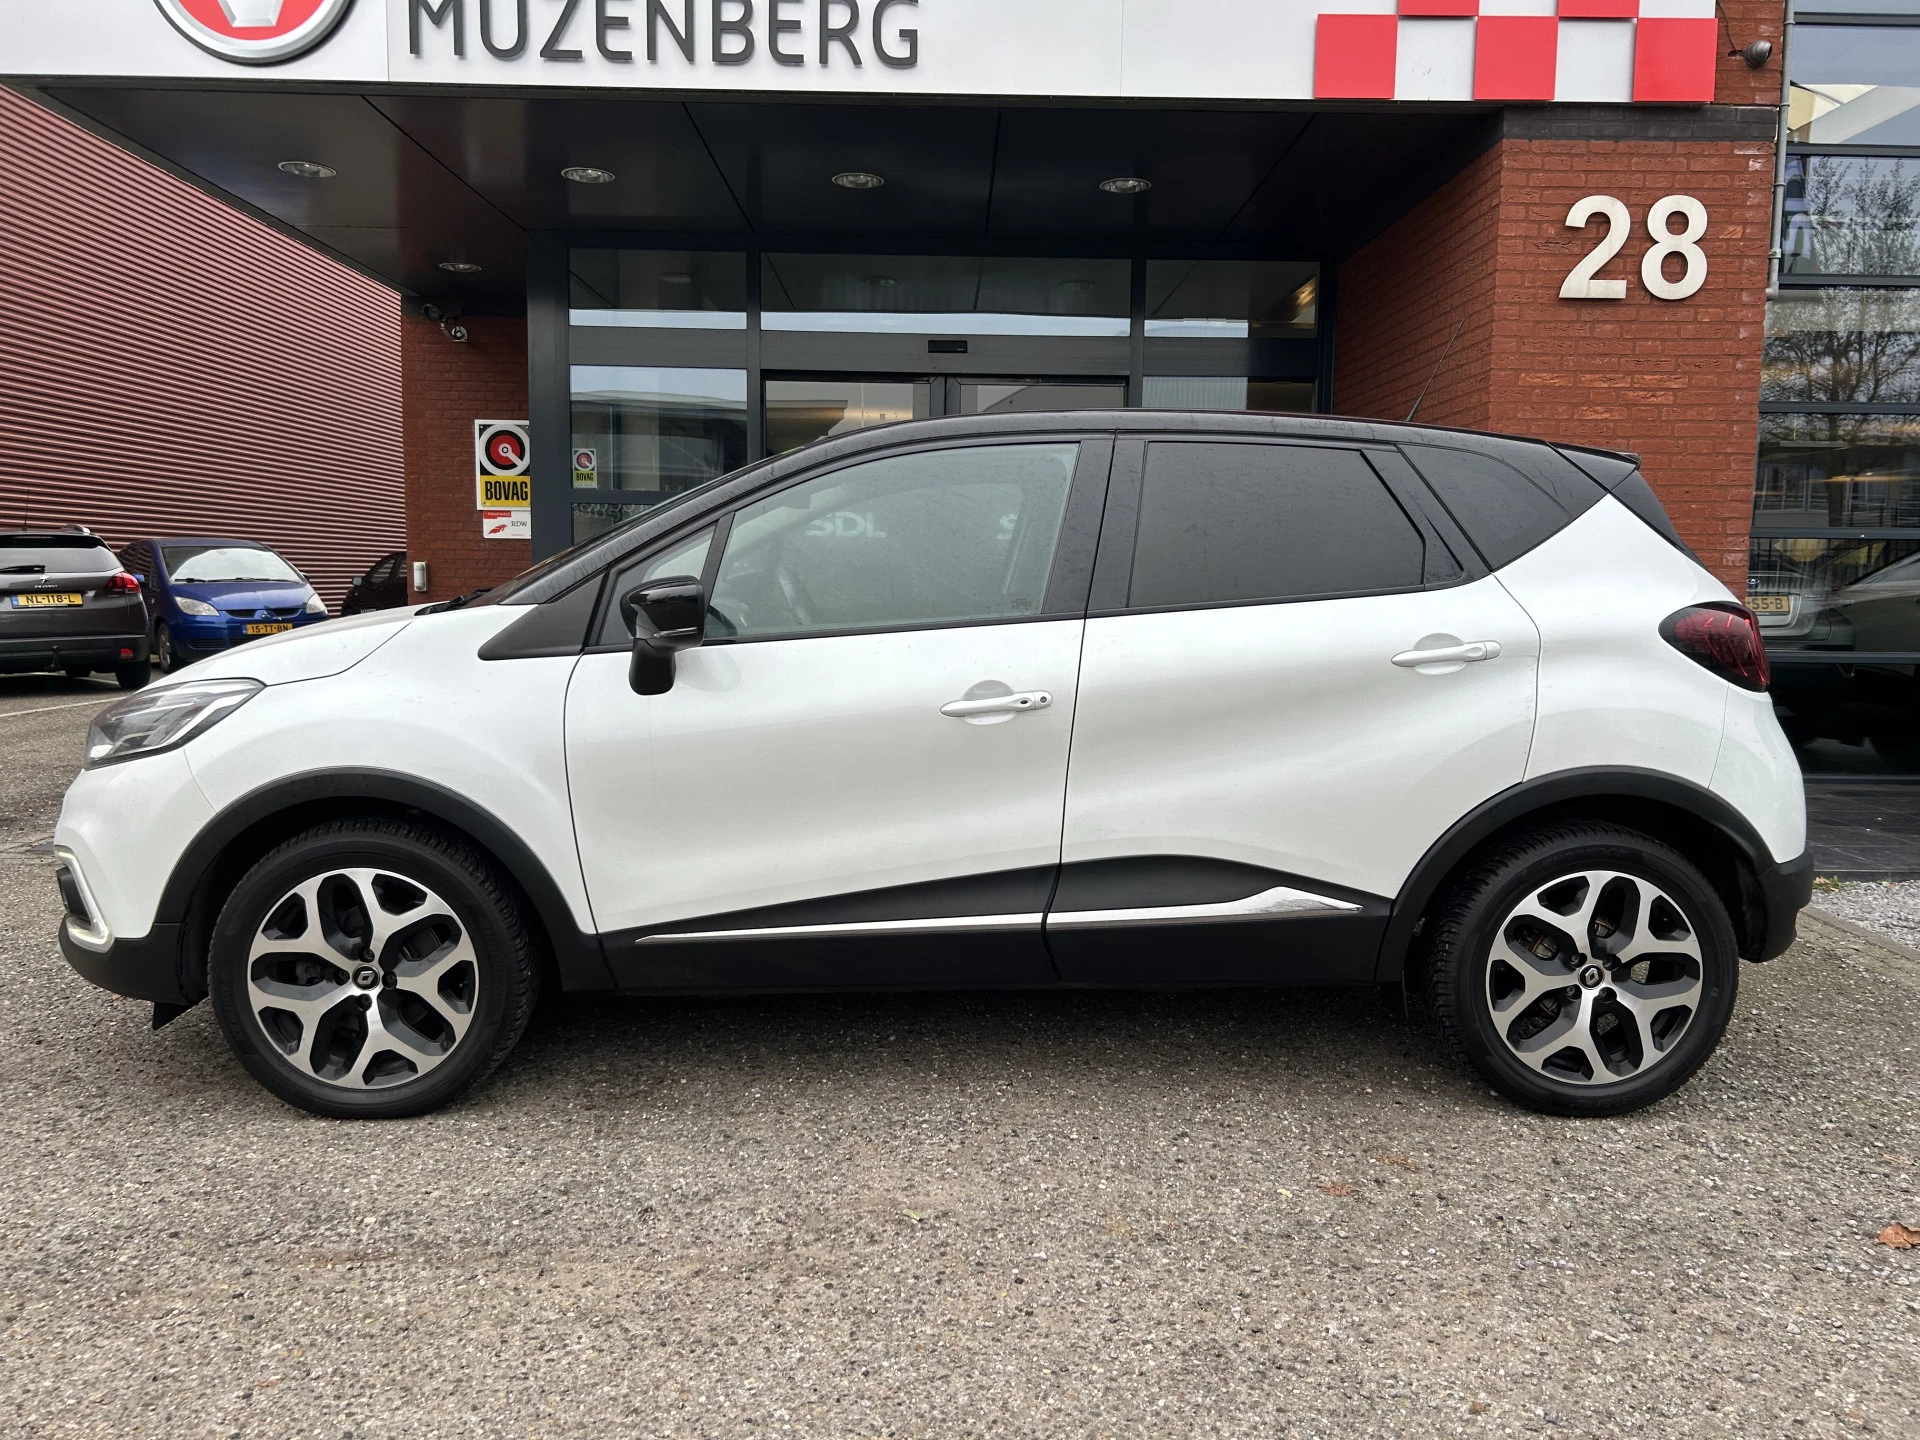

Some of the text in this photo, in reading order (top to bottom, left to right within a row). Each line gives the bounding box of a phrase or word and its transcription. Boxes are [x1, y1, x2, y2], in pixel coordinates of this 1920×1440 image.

[408, 0, 919, 67] MUZENBERG
[1559, 195, 1708, 300] 28
[575, 472, 594, 482] BOVAG
[484, 480, 529, 501] BOVAG
[25, 594, 75, 604] NL-118-L
[251, 625, 289, 634] 15-TT-BN
